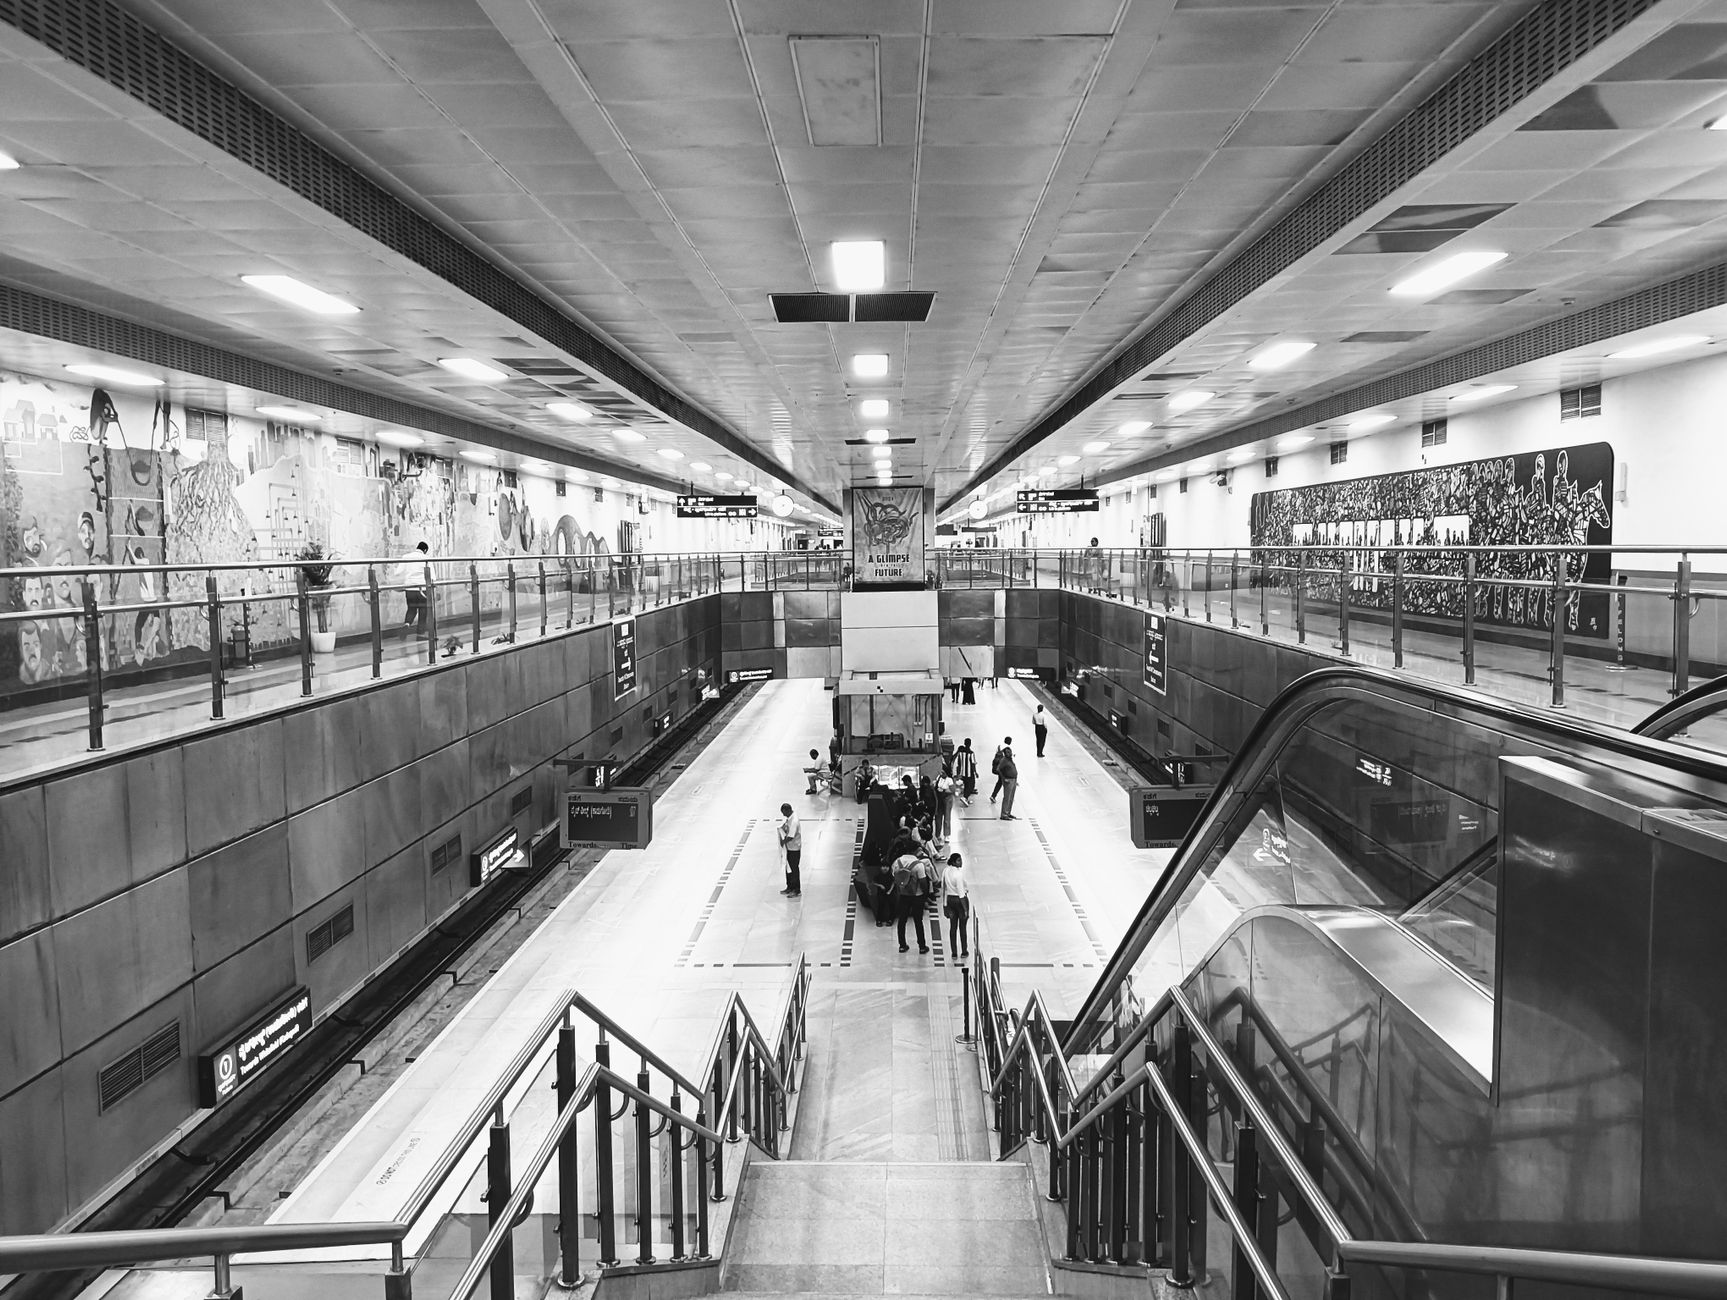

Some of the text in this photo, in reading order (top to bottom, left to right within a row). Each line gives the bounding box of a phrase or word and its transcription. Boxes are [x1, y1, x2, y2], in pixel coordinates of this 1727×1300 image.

[868, 554, 910, 563] A GLIMPSE
[875, 568, 903, 577] FUTURE
